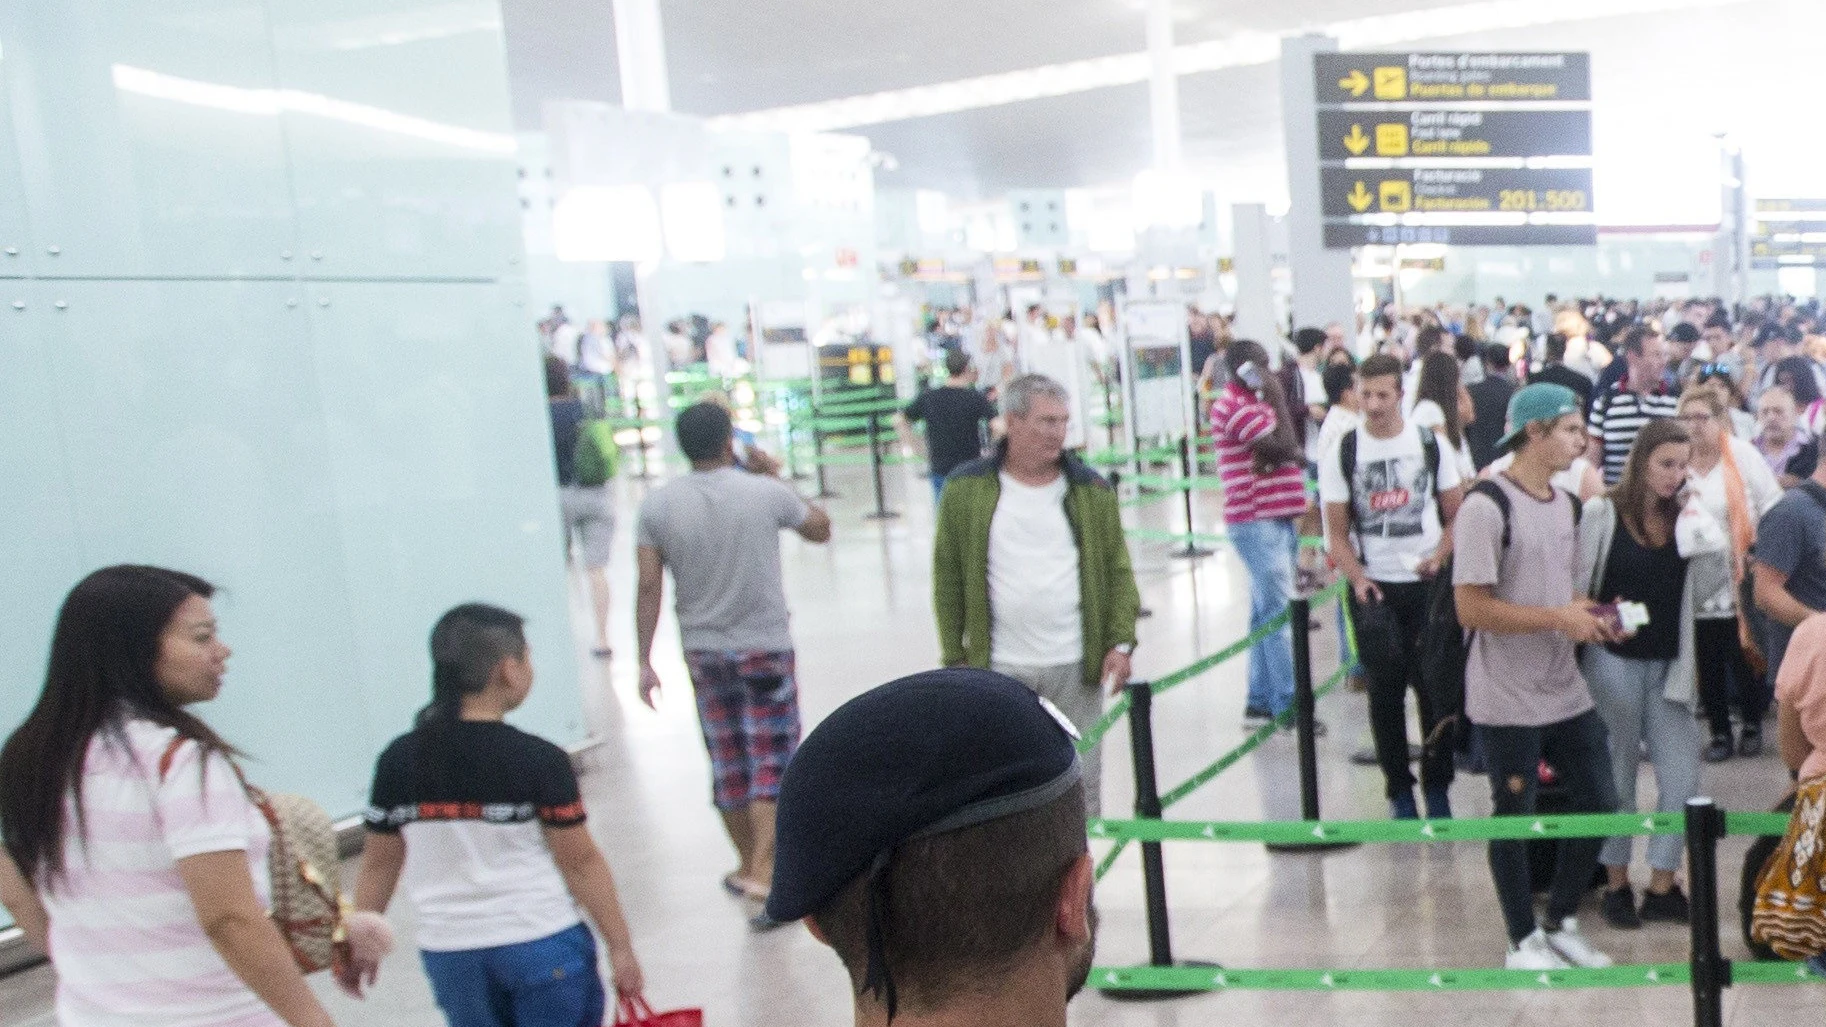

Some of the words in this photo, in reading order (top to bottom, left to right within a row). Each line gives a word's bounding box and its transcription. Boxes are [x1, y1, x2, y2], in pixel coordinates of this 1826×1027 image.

[1408, 53, 1455, 68] Portes
[1410, 83, 1464, 97] Puertas
[1466, 83, 1485, 97] de
[1487, 83, 1557, 98] embarque
